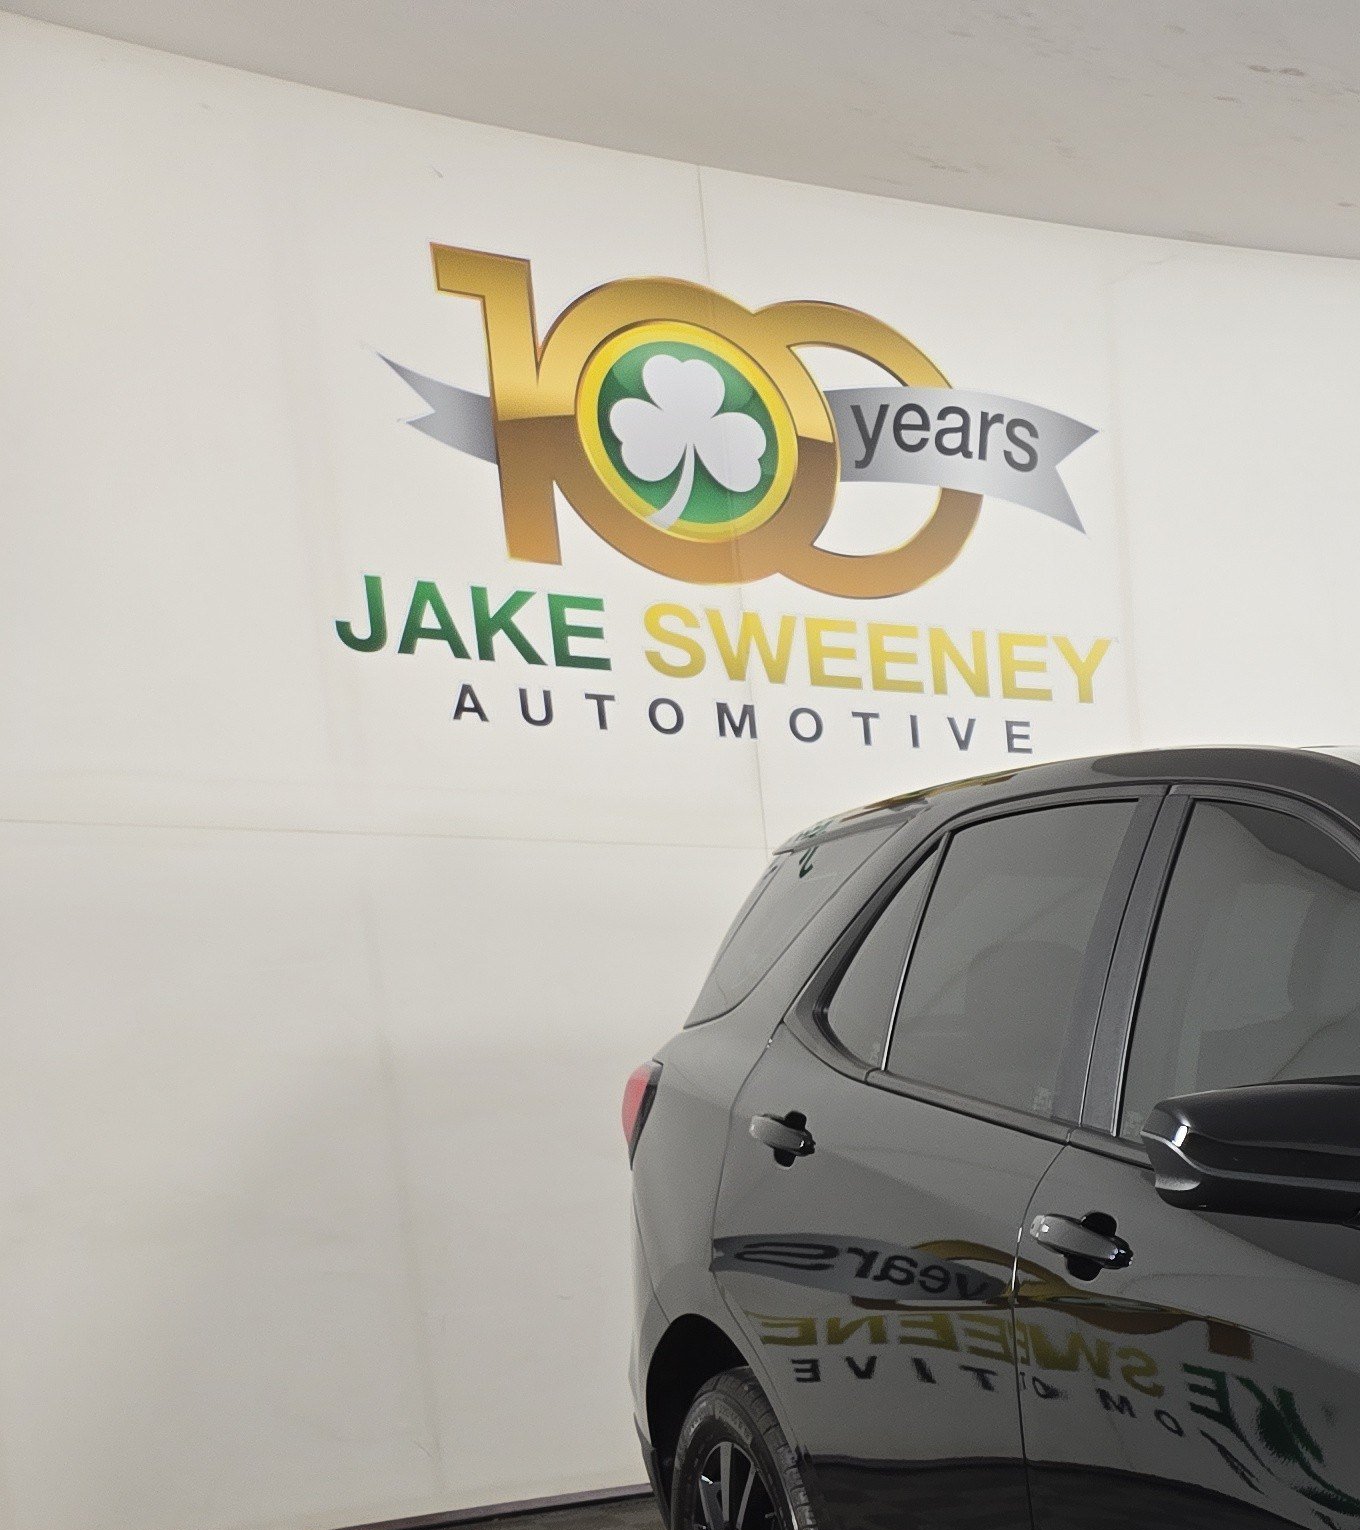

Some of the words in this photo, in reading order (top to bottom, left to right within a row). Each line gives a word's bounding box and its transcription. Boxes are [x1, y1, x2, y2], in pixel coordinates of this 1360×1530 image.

[429, 241, 984, 599] 100
[849, 400, 1040, 472] years
[335, 575, 612, 671] JAKE
[642, 603, 1112, 704] SWEENEY
[453, 683, 1034, 754] AUTOMOTIVE
